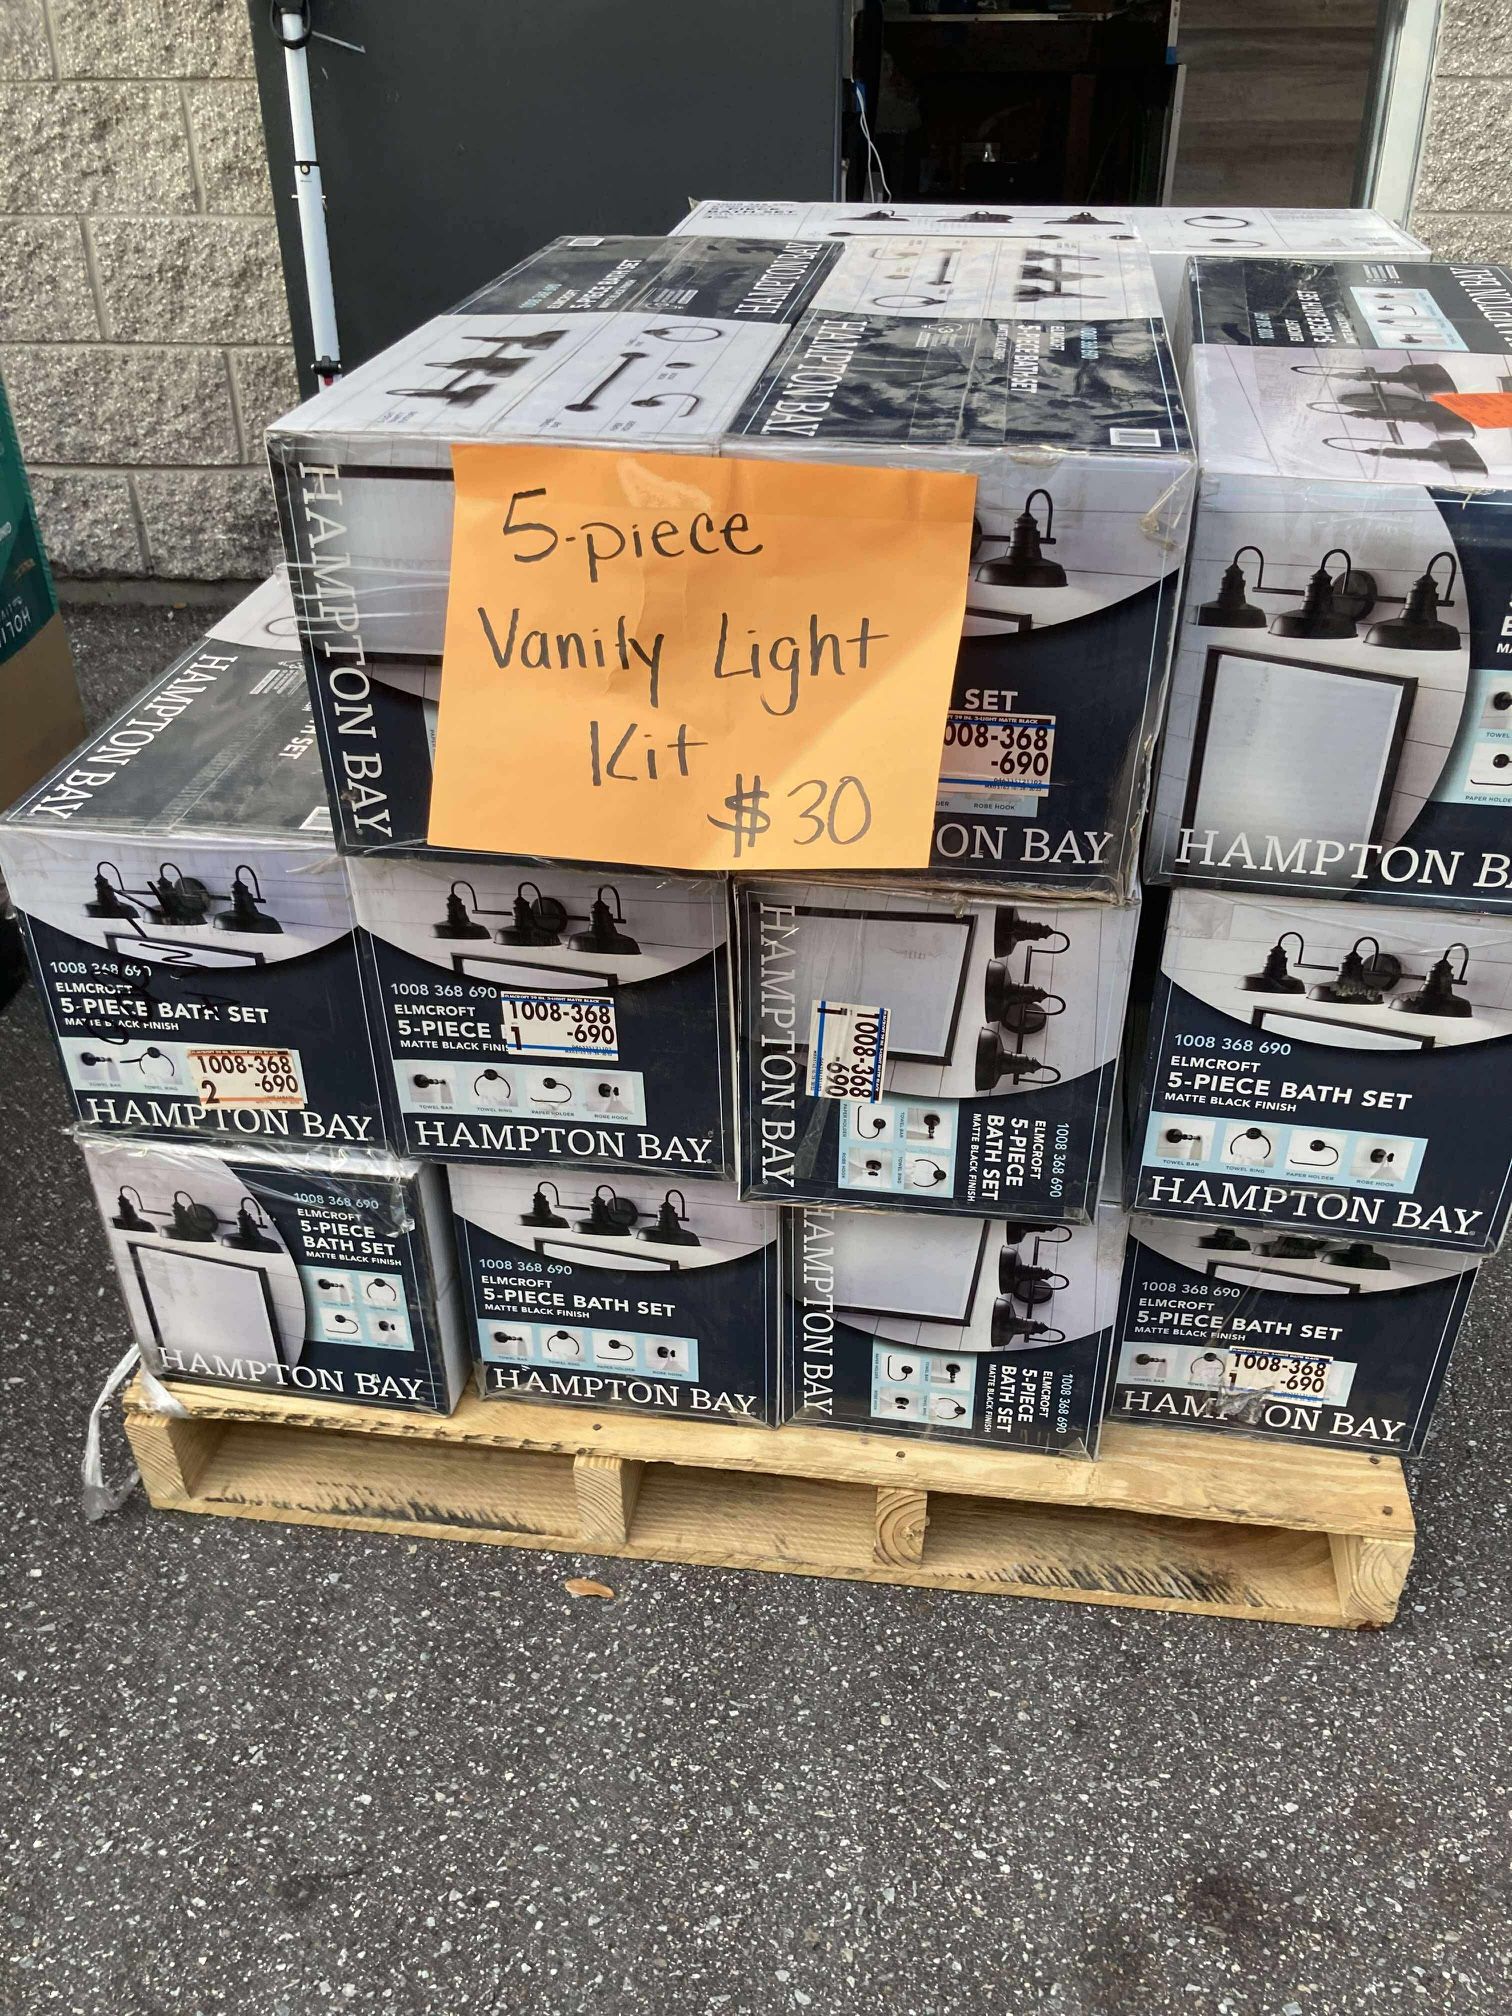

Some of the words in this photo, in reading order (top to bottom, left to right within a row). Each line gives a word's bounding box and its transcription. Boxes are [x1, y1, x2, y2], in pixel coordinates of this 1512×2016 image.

[616, 259, 642, 270] SET
[1450, 267, 1502, 286] BAY
[734, 260, 810, 313] HAMPTON
[776, 242, 822, 260] BAY
[1296, 290, 1320, 300] SET
[1300, 301, 1327, 317] BATH
[1014, 325, 1041, 355] 5-PIECE
[1306, 317, 1337, 342] 5-PIECE
[782, 320, 868, 398] HAMPTON
[1012, 355, 1039, 376] BATH
[1010, 377, 1038, 393] SET
[760, 400, 830, 437] BAY
[503, 488, 763, 583] 5-piece
[301, 464, 376, 739] HAMPTON
[341, 751, 393, 838] BAY
[478, 607, 665, 708] Vanity
[714, 612, 890, 716] Light
[87, 654, 238, 766] HAMPTON
[964, 689, 1018, 711] SET
[944, 722, 1048, 751] 008-368
[1486, 731, 1511, 739] TOWEL
[278, 737, 313, 759] SET
[590, 720, 709, 786] Kit
[990, 751, 1049, 776] -690
[30, 768, 116, 820] BAY
[707, 773, 872, 858] $30
[1019, 828, 1114, 864] BAY
[1175, 828, 1464, 886] HAMPTON
[50, 961, 87, 974] 1008
[55, 982, 133, 994] ELMCROFT
[390, 983, 429, 996] 1008
[434, 985, 463, 997] 368
[469, 986, 498, 999] 690
[61, 998, 148, 1017] 5-PIECE
[158, 1003, 220, 1021] BATH
[227, 1006, 269, 1024] SET
[395, 1004, 476, 1017] ELMCROFT
[510, 1000, 611, 1025] 1008-368
[759, 902, 796, 1109] HAMPTON
[817, 1007, 848, 1016] 1
[143, 1021, 180, 1031] FINISH
[398, 1020, 492, 1039] 5-PIECE
[510, 1026, 522, 1050] 1
[567, 1024, 615, 1044] -690
[400, 1040, 439, 1049] MATTE
[442, 1041, 479, 1051] BLACK
[849, 1013, 880, 1098] 1008-368
[1174, 1033, 1215, 1048] 1008
[1221, 1037, 1253, 1052] 368
[1258, 1041, 1292, 1056] 690
[197, 1055, 292, 1074] 1008-368
[825, 1056, 850, 1097] -690
[1170, 1055, 1261, 1073] ELMCROFT
[201, 1079, 220, 1104] 2
[255, 1074, 299, 1093] -690
[1167, 1072, 1271, 1097] 5-PIECE
[1280, 1082, 1352, 1104] BATH
[1361, 1090, 1413, 1110] SET
[1164, 1092, 1206, 1104] MATTE
[1209, 1096, 1251, 1108] BLACK
[1254, 1100, 1297, 1112] FINISH
[86, 1098, 289, 1135] HAMPTON
[303, 1111, 372, 1141] BAY
[972, 1113, 982, 1141] MATTE
[414, 1120, 625, 1157] HAMPTON
[637, 1132, 712, 1163] BAY
[985, 1114, 1005, 1162] BATH
[1055, 1122, 1070, 1150] 1008
[761, 1117, 795, 1188] BAY
[969, 1144, 979, 1172] BLACK
[1006, 1117, 1029, 1187] 5-PIECE
[1029, 1120, 1047, 1180] ELMCROFT
[1052, 1153, 1067, 1174] 368
[967, 1174, 976, 1202] FINISH
[981, 1169, 1000, 1201] SET
[1049, 1177, 1064, 1198] 690
[1310, 1173, 1334, 1181] HOLDER
[294, 1193, 324, 1204] 1008
[328, 1196, 351, 1207] 368
[356, 1199, 379, 1209] 690
[1148, 1176, 1385, 1228] HAMPTON
[1392, 1202, 1483, 1236] BAY
[297, 1208, 361, 1221] ELMCROFT
[300, 1220, 376, 1239] 5-PIECE
[302, 1235, 354, 1252] BATH
[361, 1242, 395, 1256] SET
[306, 1251, 337, 1260] MATTE
[339, 1255, 369, 1263] BLACK
[371, 1257, 402, 1266] FINISH
[479, 1258, 513, 1270] 1008
[517, 1261, 542, 1273] 368
[547, 1263, 572, 1275] 690
[481, 1275, 553, 1289] ELMCROFT
[1142, 1281, 1176, 1293] 1008
[1181, 1284, 1208, 1296] 368
[1213, 1287, 1240, 1298] 690
[483, 1288, 565, 1307] 5-PIECE
[573, 1295, 630, 1313] BATH
[637, 1301, 676, 1317] SET
[484, 1304, 519, 1313] MATTE
[521, 1306, 554, 1316] BLACK
[557, 1309, 590, 1318] FINISH
[1139, 1298, 1215, 1311] ELMCROFT
[1134, 1326, 1169, 1336] MATTE
[1172, 1329, 1207, 1338] BLACK
[1211, 1332, 1246, 1341] FINISH
[1136, 1310, 1224, 1330] 5-PIECE
[1232, 1317, 1292, 1336] BATH
[1299, 1325, 1343, 1341] SET
[157, 1346, 344, 1392] HAMPTON
[355, 1373, 424, 1400] BAY
[988, 1364, 996, 1386] MATTE
[1234, 1353, 1327, 1377] 1008-368
[493, 1368, 679, 1407] HAMPTON
[690, 1389, 757, 1415] BAY
[803, 1361, 833, 1415] BAY
[1000, 1365, 1017, 1406] BATH
[1038, 1370, 1053, 1418] ELMCROFT
[1060, 1373, 1073, 1396] 1008
[1229, 1372, 1238, 1391] 1
[1280, 1375, 1325, 1393] -690
[986, 1388, 994, 1409] BLACK
[1018, 1368, 1038, 1423] 5-PIECE
[1058, 1397, 1071, 1416] 368
[984, 1410, 992, 1433] FINISH
[997, 1411, 1013, 1433] SET
[1056, 1417, 1069, 1434] 690
[1121, 1390, 1322, 1432] HAMON
[1330, 1412, 1405, 1442] BAY
